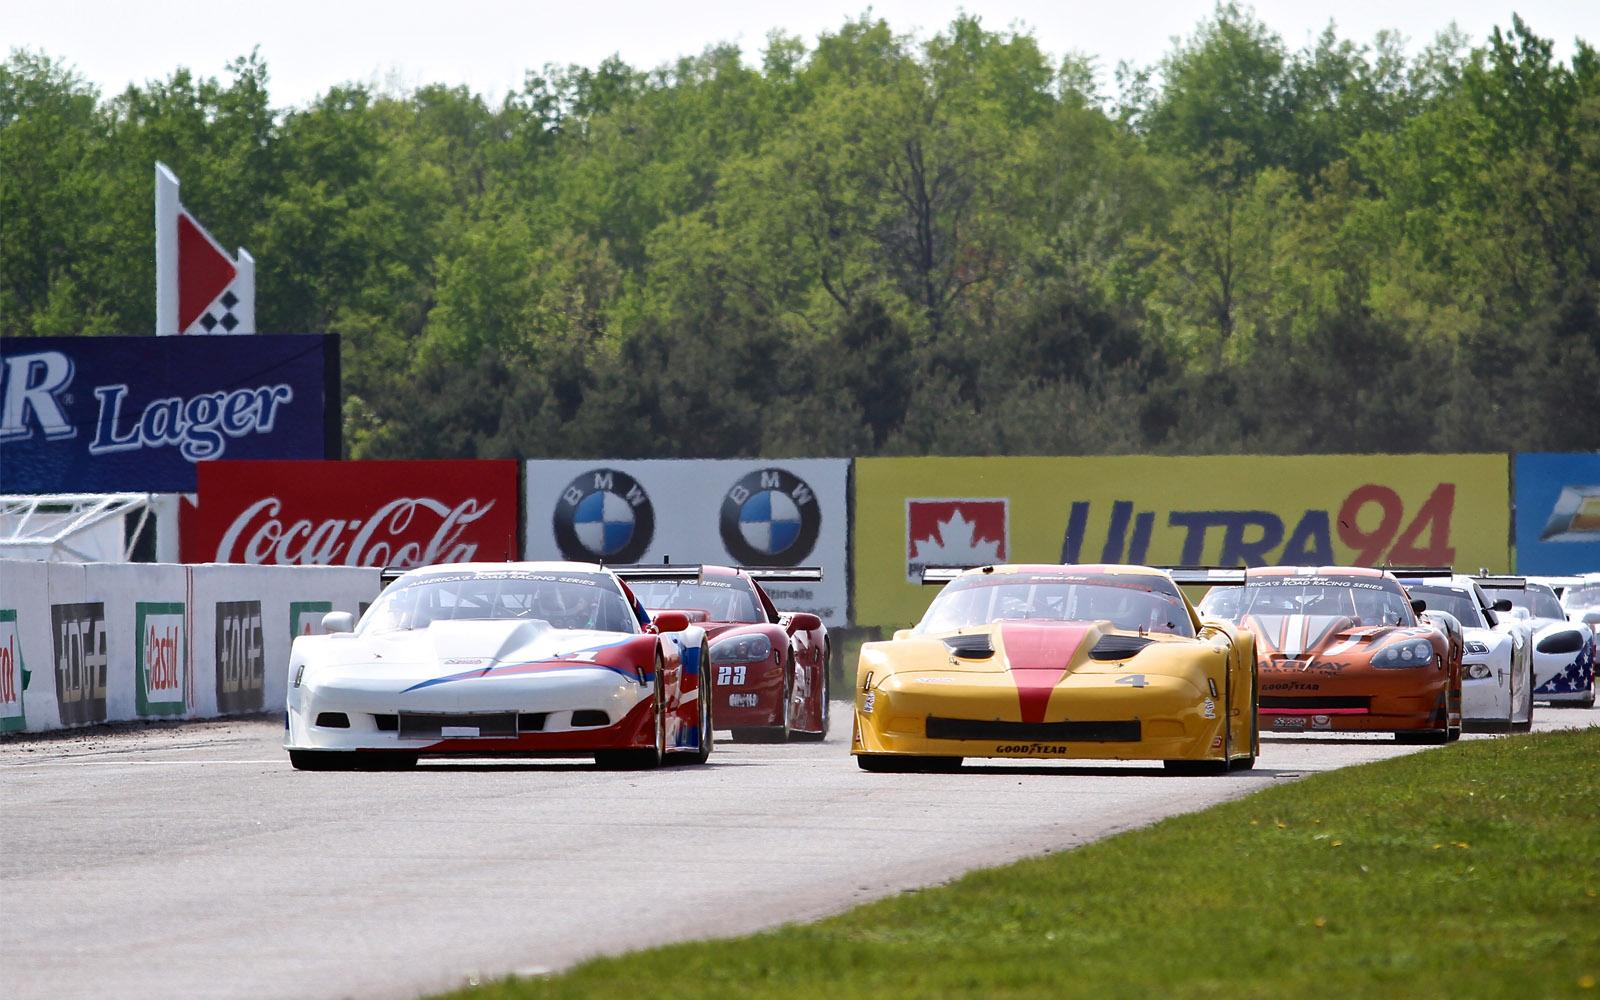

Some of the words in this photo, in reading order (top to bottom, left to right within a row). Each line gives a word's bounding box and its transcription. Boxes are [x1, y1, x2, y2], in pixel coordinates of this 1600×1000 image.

[89, 384, 293, 462] Lager
[563, 472, 645, 507] BMW
[730, 471, 812, 506] BMW
[215, 498, 496, 566] Coca-Cola
[408, 575, 471, 587] AMERICA'S
[510, 574, 556, 582] RACING
[559, 576, 596, 586] SERIES
[1281, 579, 1311, 587] ROAD
[1312, 580, 1350, 588] RACING
[1353, 583, 1384, 591] SERIES
[60, 618, 106, 703] EDGE
[221, 616, 262, 693] EDGE
[717, 665, 747, 686] 23
[1115, 674, 1149, 688] 4
[1261, 681, 1321, 691] GOODYEAR
[996, 743, 1068, 755] GOODYEAR
